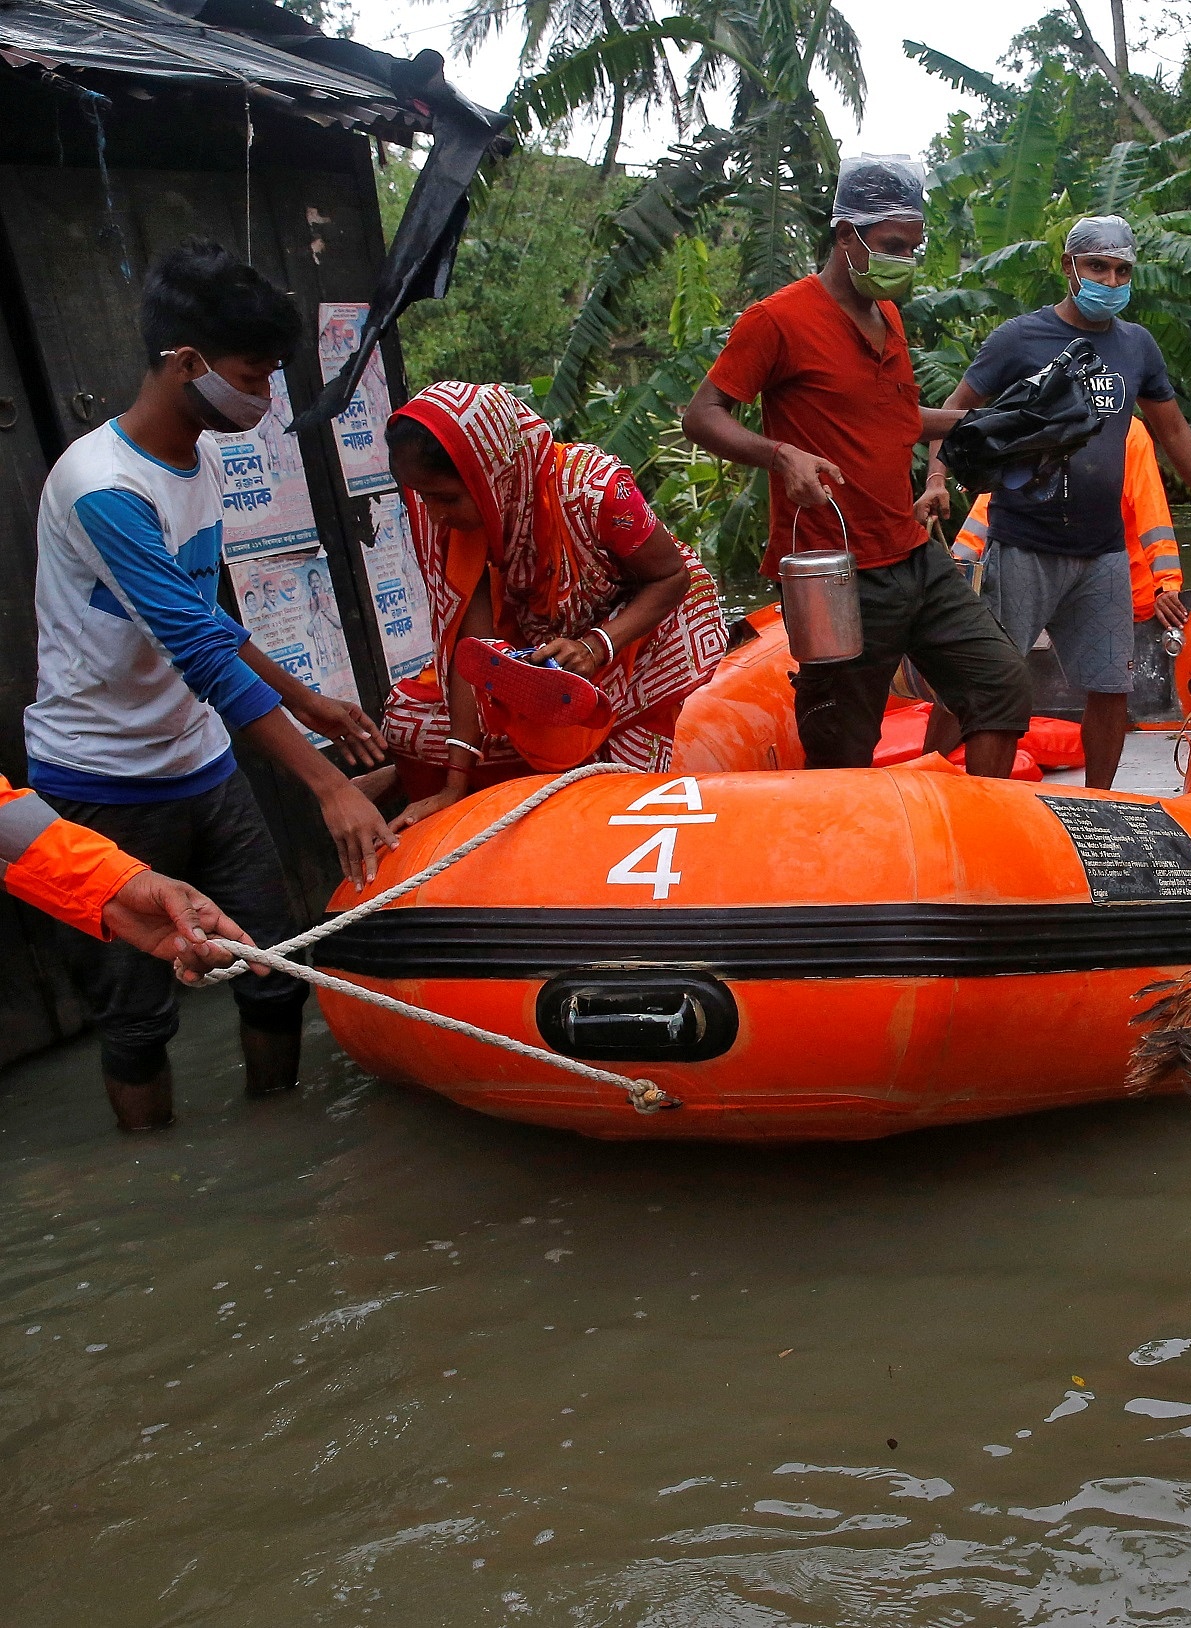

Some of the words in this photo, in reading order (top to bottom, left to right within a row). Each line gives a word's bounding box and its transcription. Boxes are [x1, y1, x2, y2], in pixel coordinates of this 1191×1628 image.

[341, 430, 374, 451] নায়ক
[223, 487, 273, 512] নায়ক
[384, 615, 414, 638] নায়ক
[626, 776, 703, 811] A
[606, 827, 682, 900] 4
